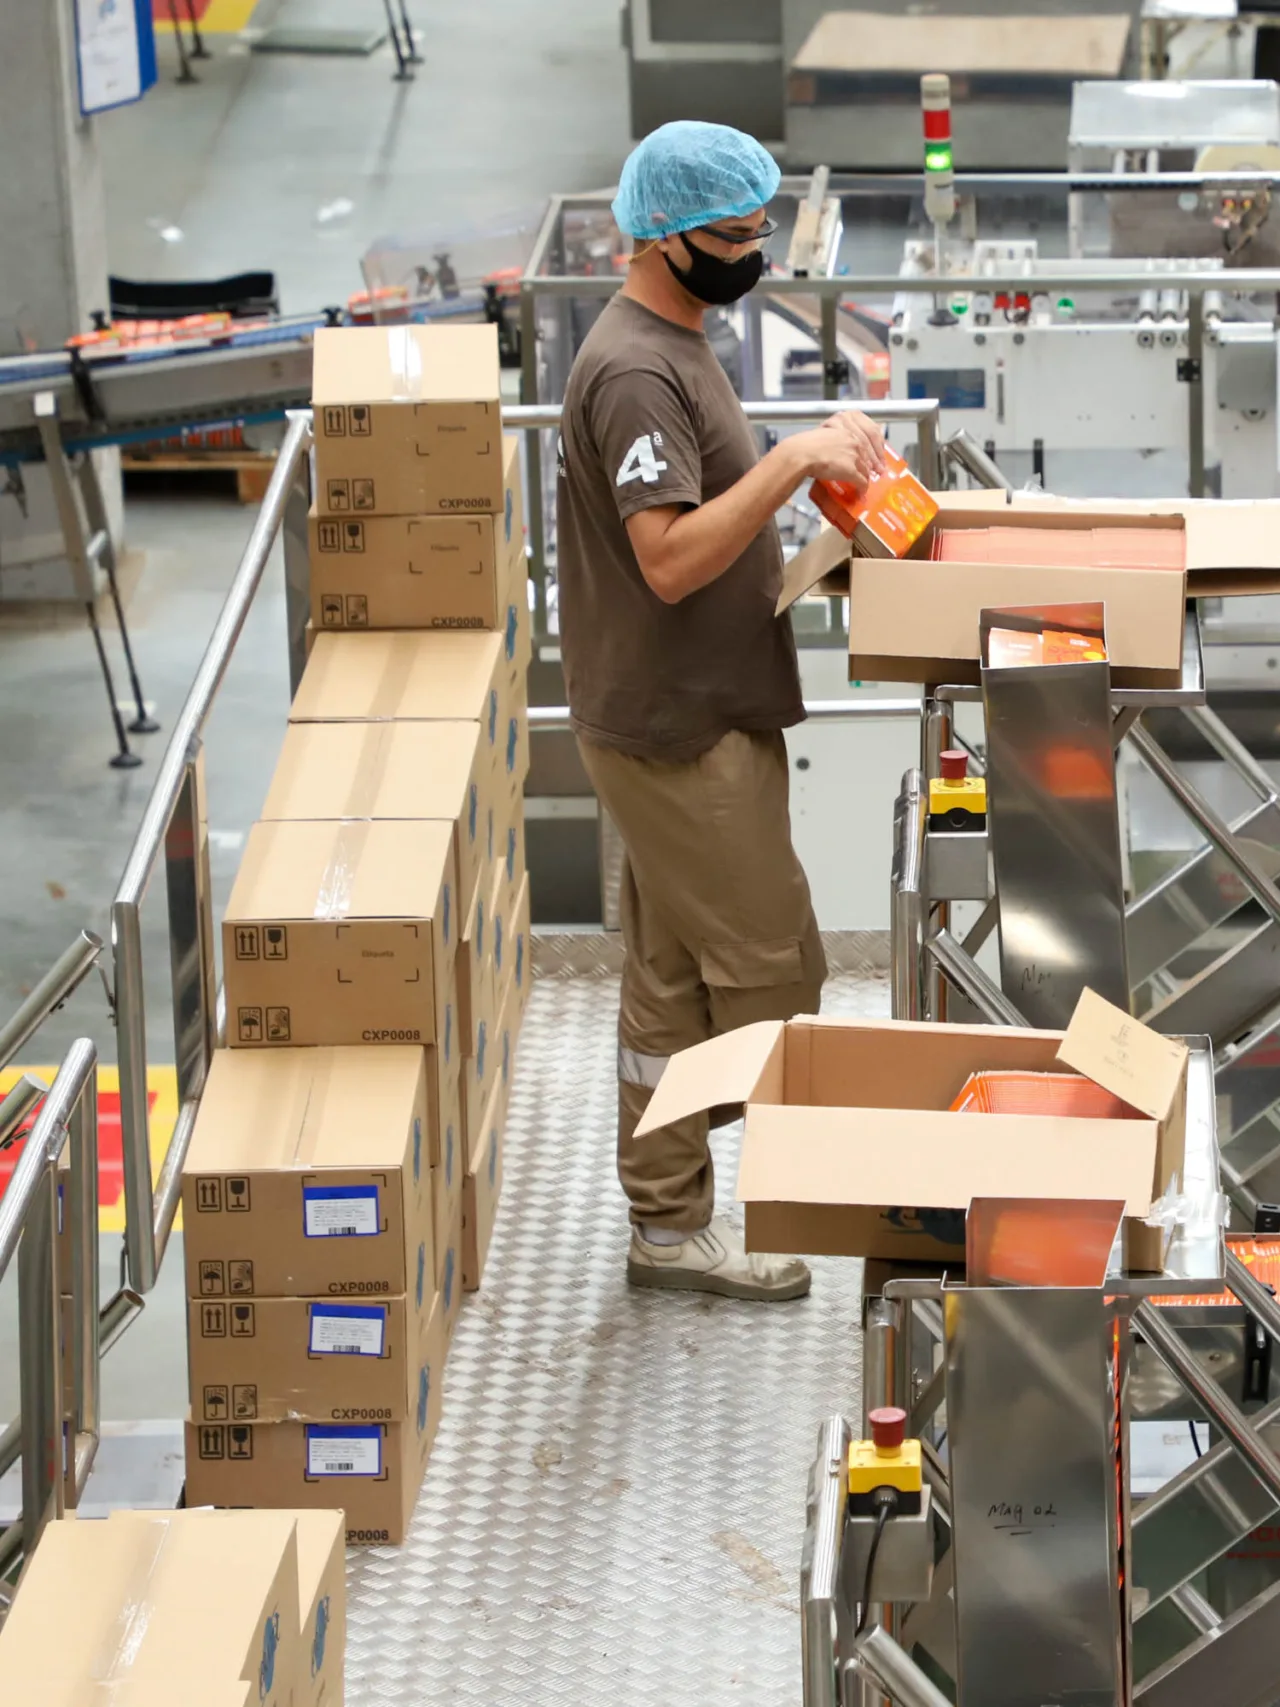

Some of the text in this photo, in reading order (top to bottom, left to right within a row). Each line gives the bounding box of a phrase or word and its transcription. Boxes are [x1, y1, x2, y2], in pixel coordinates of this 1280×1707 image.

[438, 498, 492, 509] CXP0008
[431, 616, 485, 628] CXP0008
[361, 1029, 421, 1041] CXP0008
[327, 1280, 390, 1293] CXP0008
[331, 1407, 392, 1420] CXP0008
[345, 1529, 390, 1542] P0008
